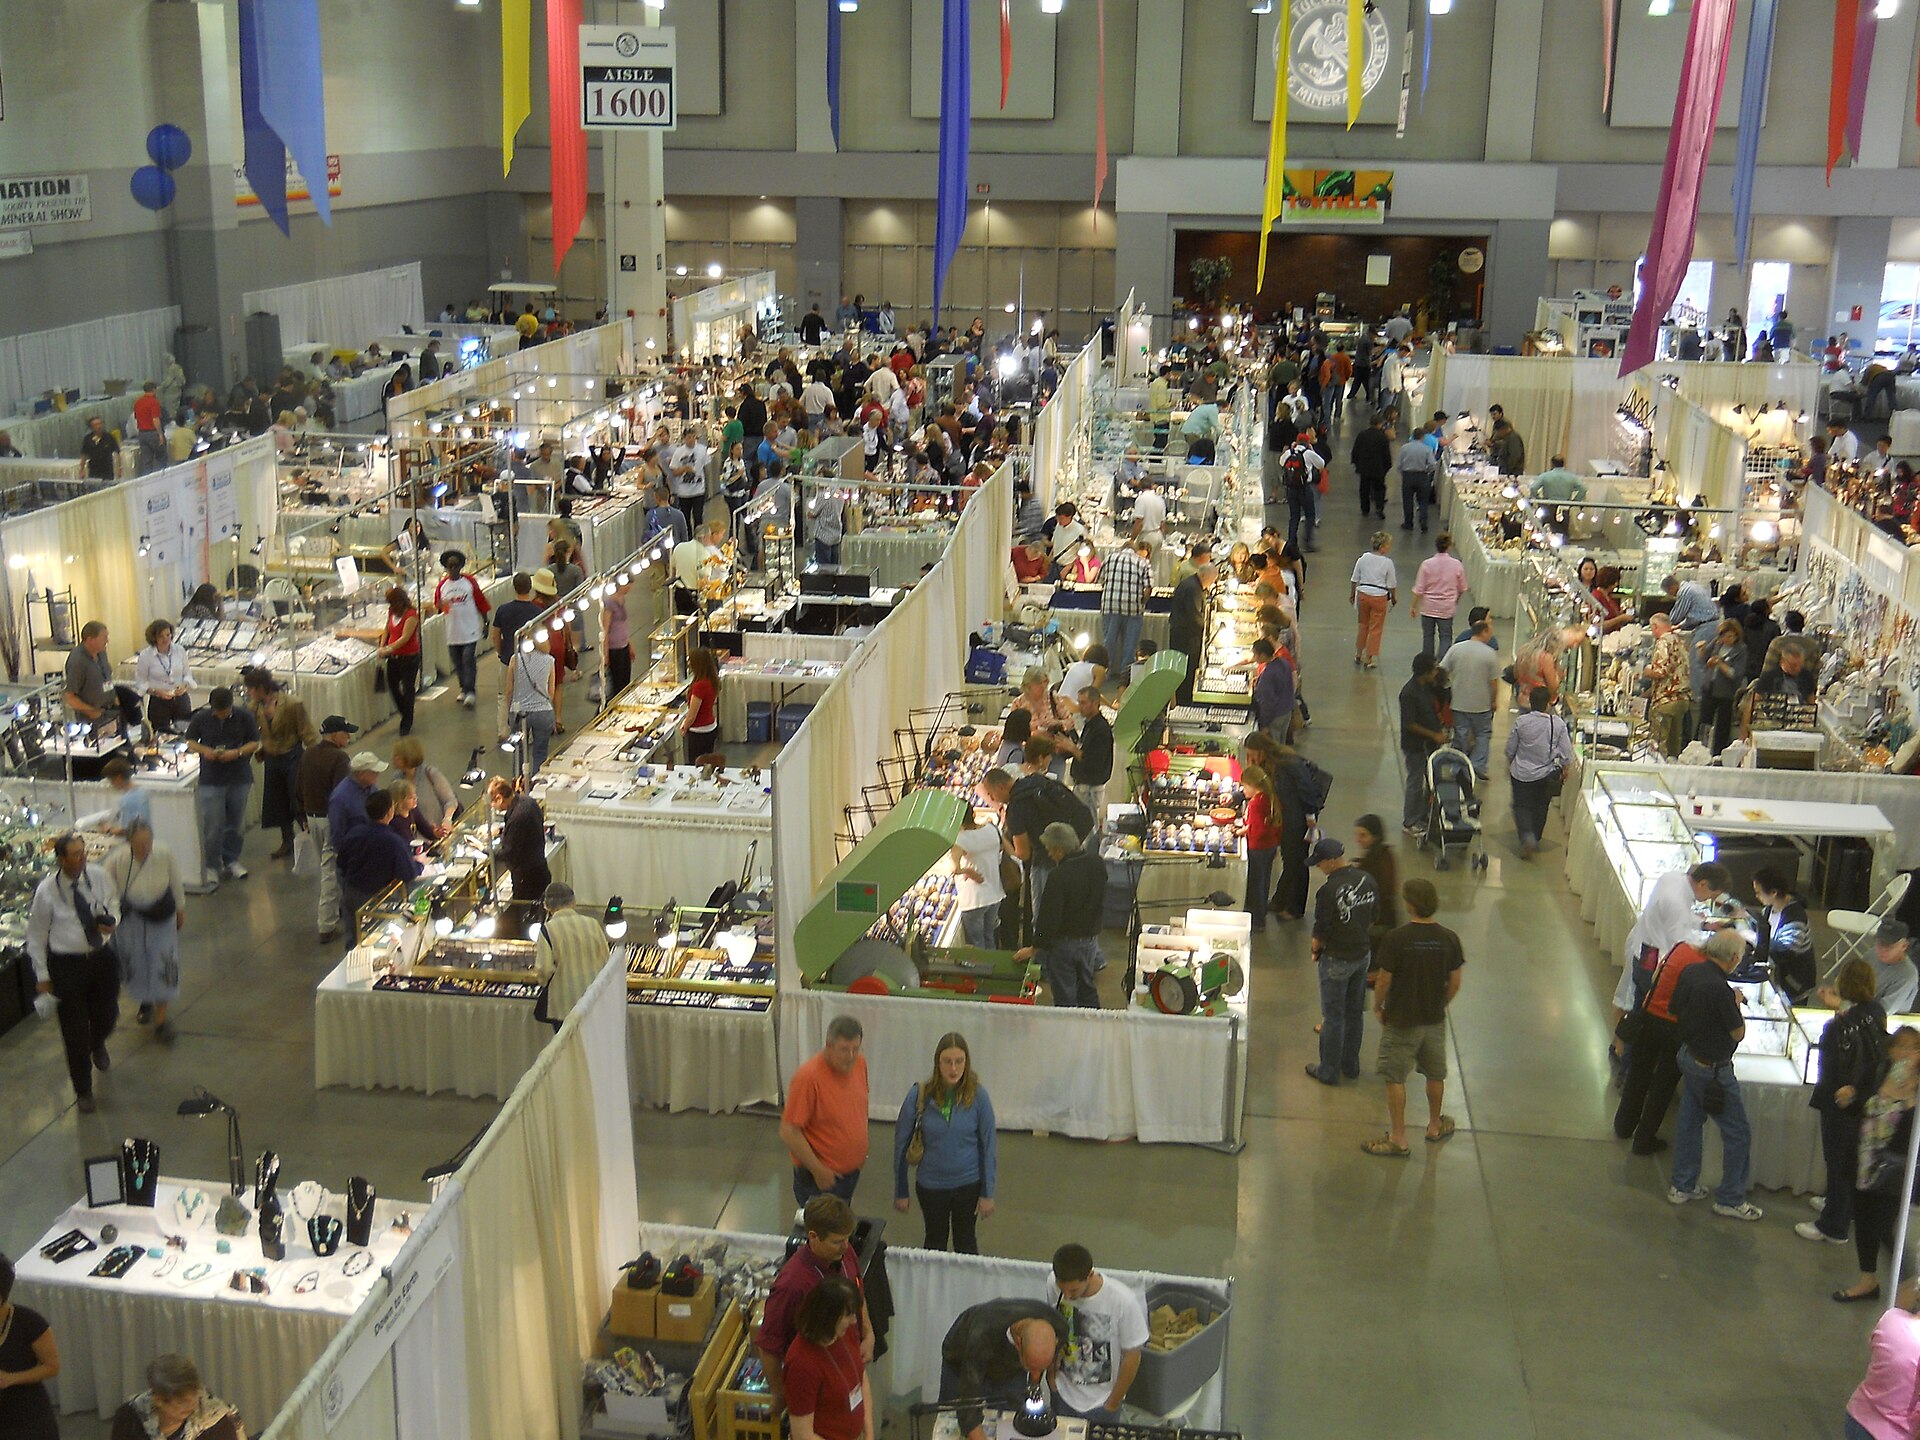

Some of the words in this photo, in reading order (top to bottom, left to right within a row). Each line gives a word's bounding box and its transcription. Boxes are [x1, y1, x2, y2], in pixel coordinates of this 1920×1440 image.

[1361, 24, 1386, 90] SOCIETY
[604, 69, 653, 81] AISLE
[593, 88, 665, 117] 1600
[1, 211, 47, 225] MINERAL
[50, 208, 83, 220] SHOW
[374, 1305, 393, 1336] Down
